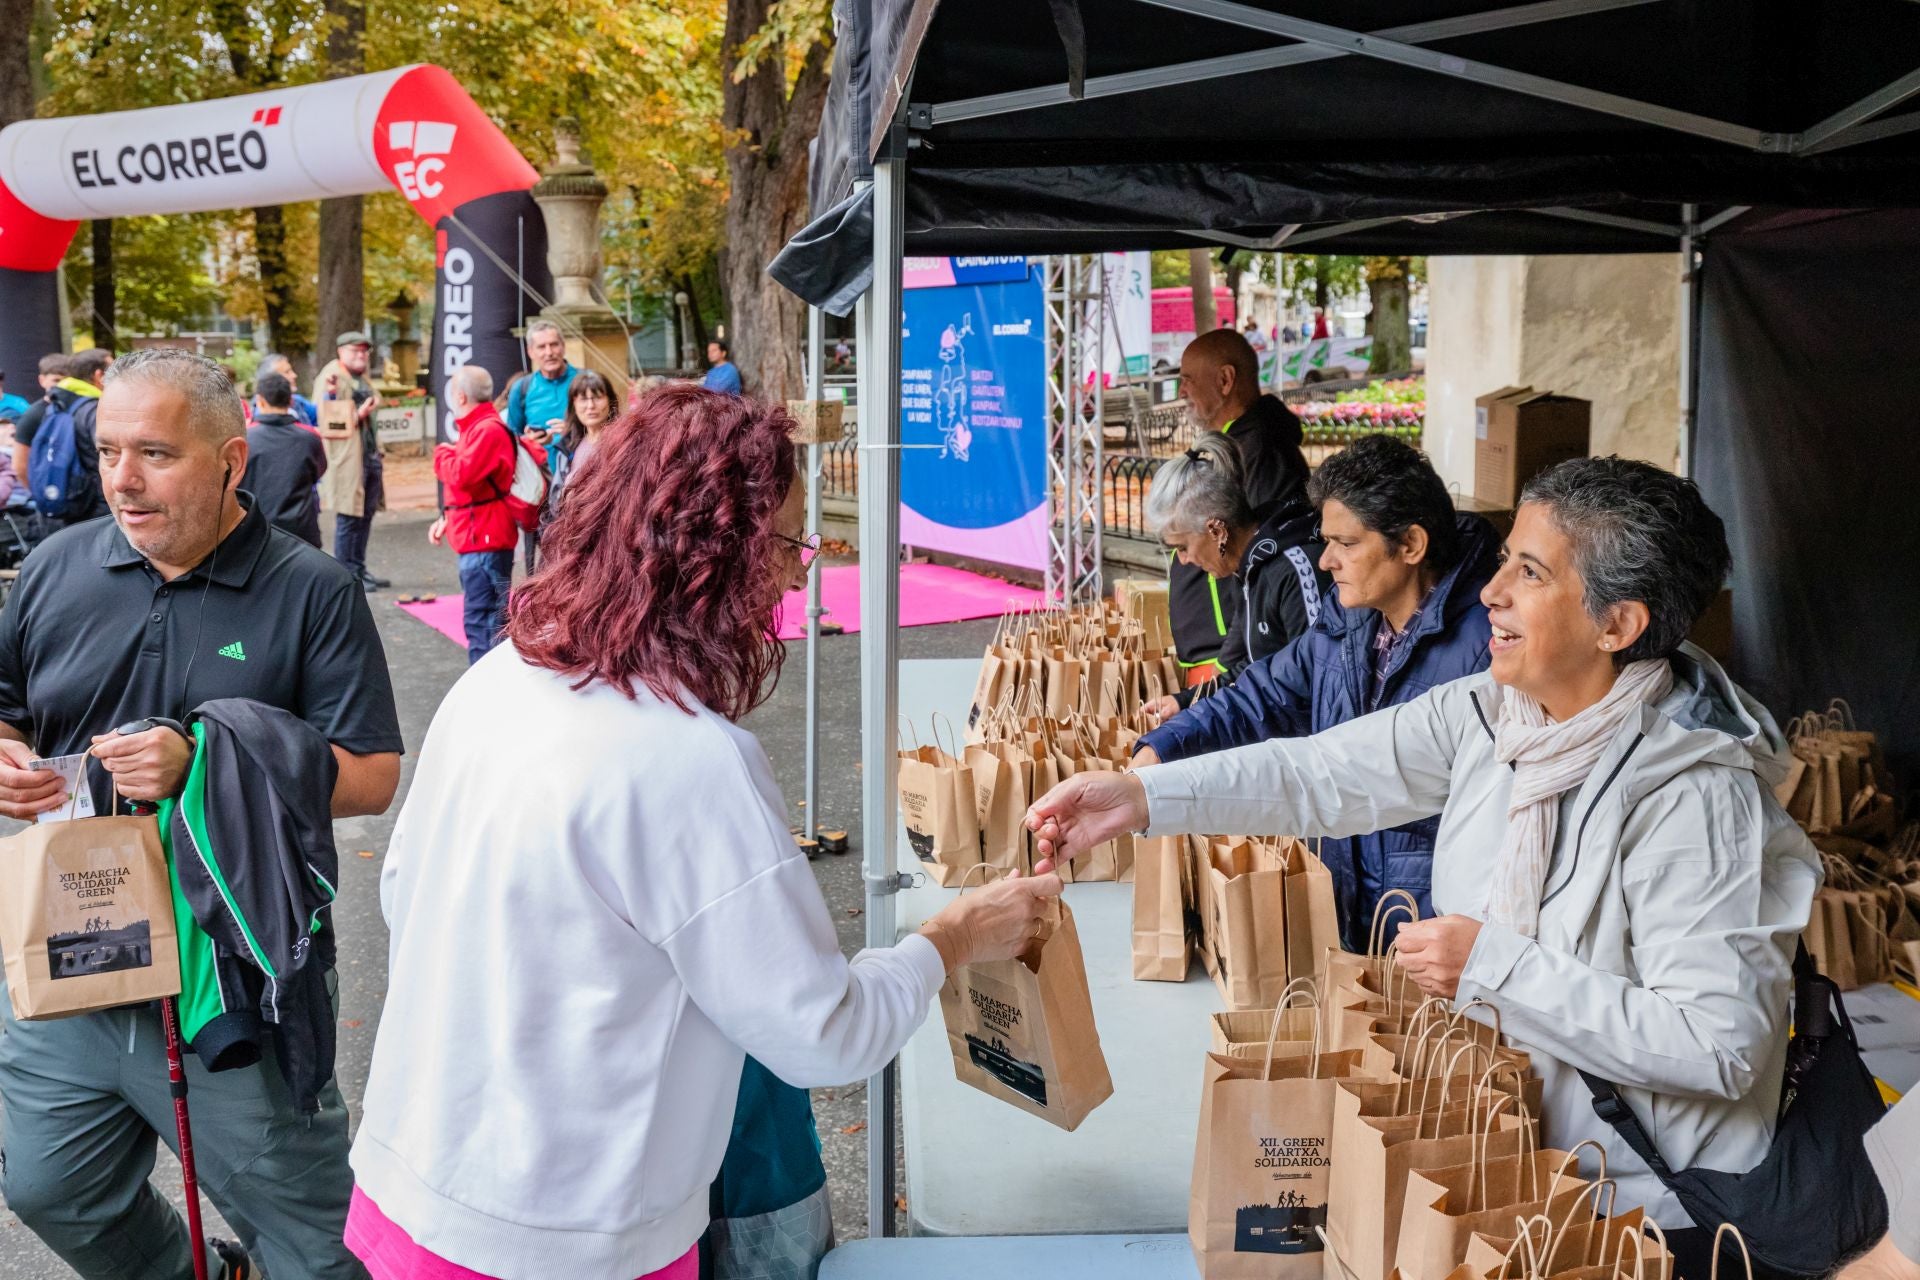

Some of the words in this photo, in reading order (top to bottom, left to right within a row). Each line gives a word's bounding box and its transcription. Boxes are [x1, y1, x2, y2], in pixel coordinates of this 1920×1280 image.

[72, 150, 116, 188] EL
[118, 130, 268, 184] CORREO
[394, 158, 445, 201] EC
[443, 247, 475, 443] CRREO
[376, 419, 410, 430] RREO
[219, 648, 246, 661] adidas
[59, 872, 76, 883] XII
[78, 867, 131, 881] MARCHA
[63, 876, 126, 891] SOLIDARIA
[77, 886, 116, 898] GREEN
[971, 996, 1019, 1025] SOLIDARIA
[980, 994, 1022, 1018] MARCHA
[981, 1010, 1010, 1029] GREEN
[1259, 1137, 1280, 1147] XII.
[1282, 1137, 1326, 1147] GREEN
[1264, 1147, 1320, 1157] MARTXA
[1254, 1157, 1332, 1168] SOLIDARIOA
